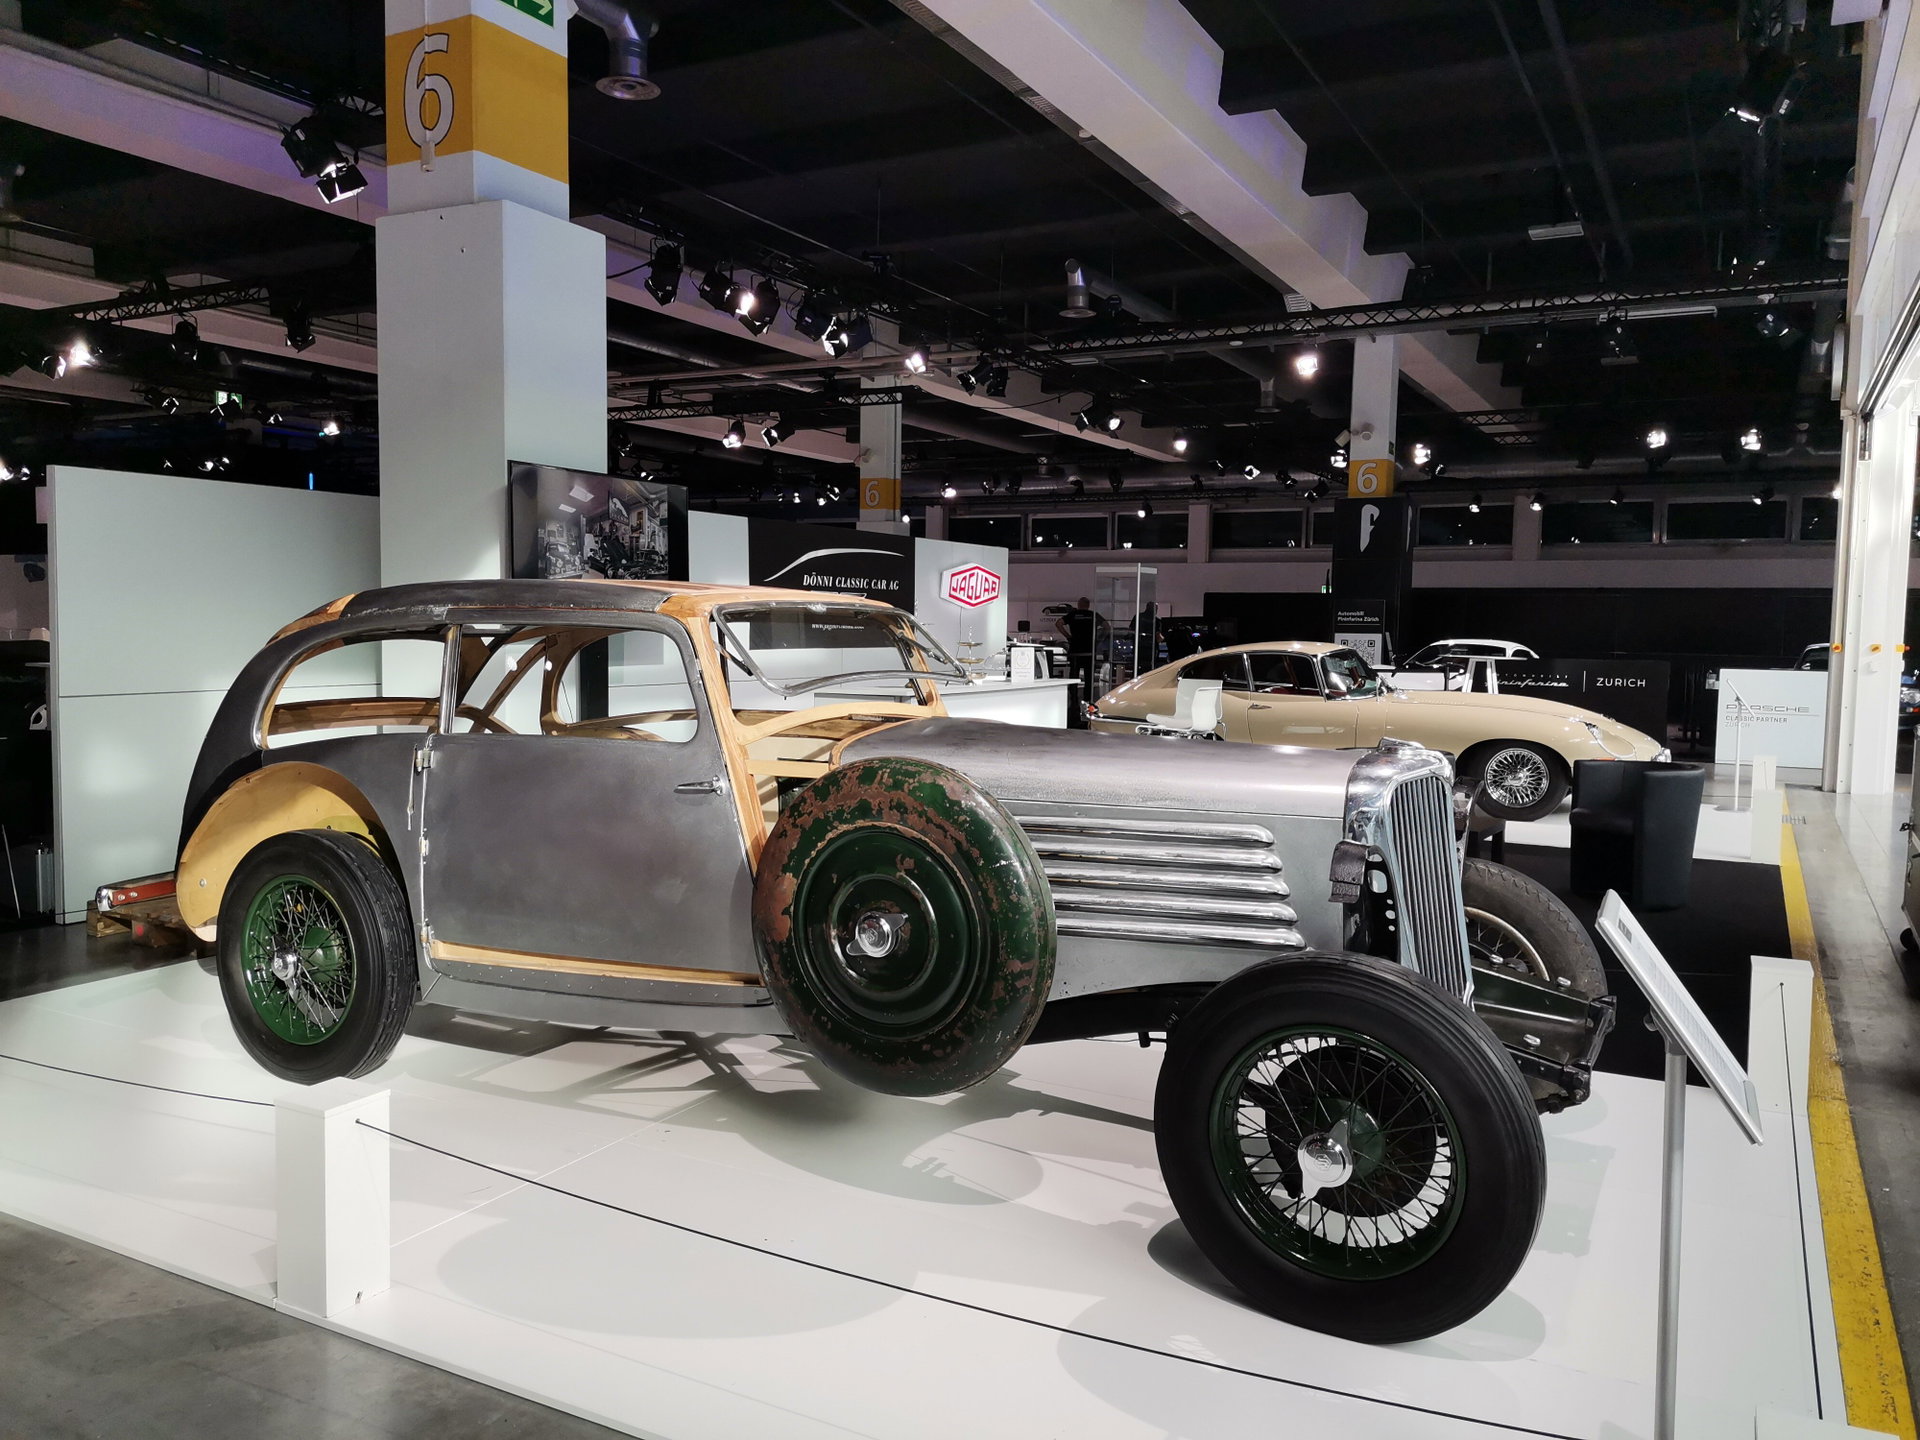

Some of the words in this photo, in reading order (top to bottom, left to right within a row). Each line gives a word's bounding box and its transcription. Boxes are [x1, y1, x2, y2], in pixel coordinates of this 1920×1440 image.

[404, 33, 454, 148] 6
[1357, 462, 1378, 494] 6
[865, 480, 880, 507] 6
[803, 572, 833, 587] DÖNNI
[835, 576, 870, 589] CLASSIC
[871, 579, 887, 590] CAR
[888, 580, 900, 591] AG
[952, 571, 997, 600] JAGUAR
[1485, 679, 1569, 688] ininfarina
[1596, 677, 1646, 688] ZURICH
